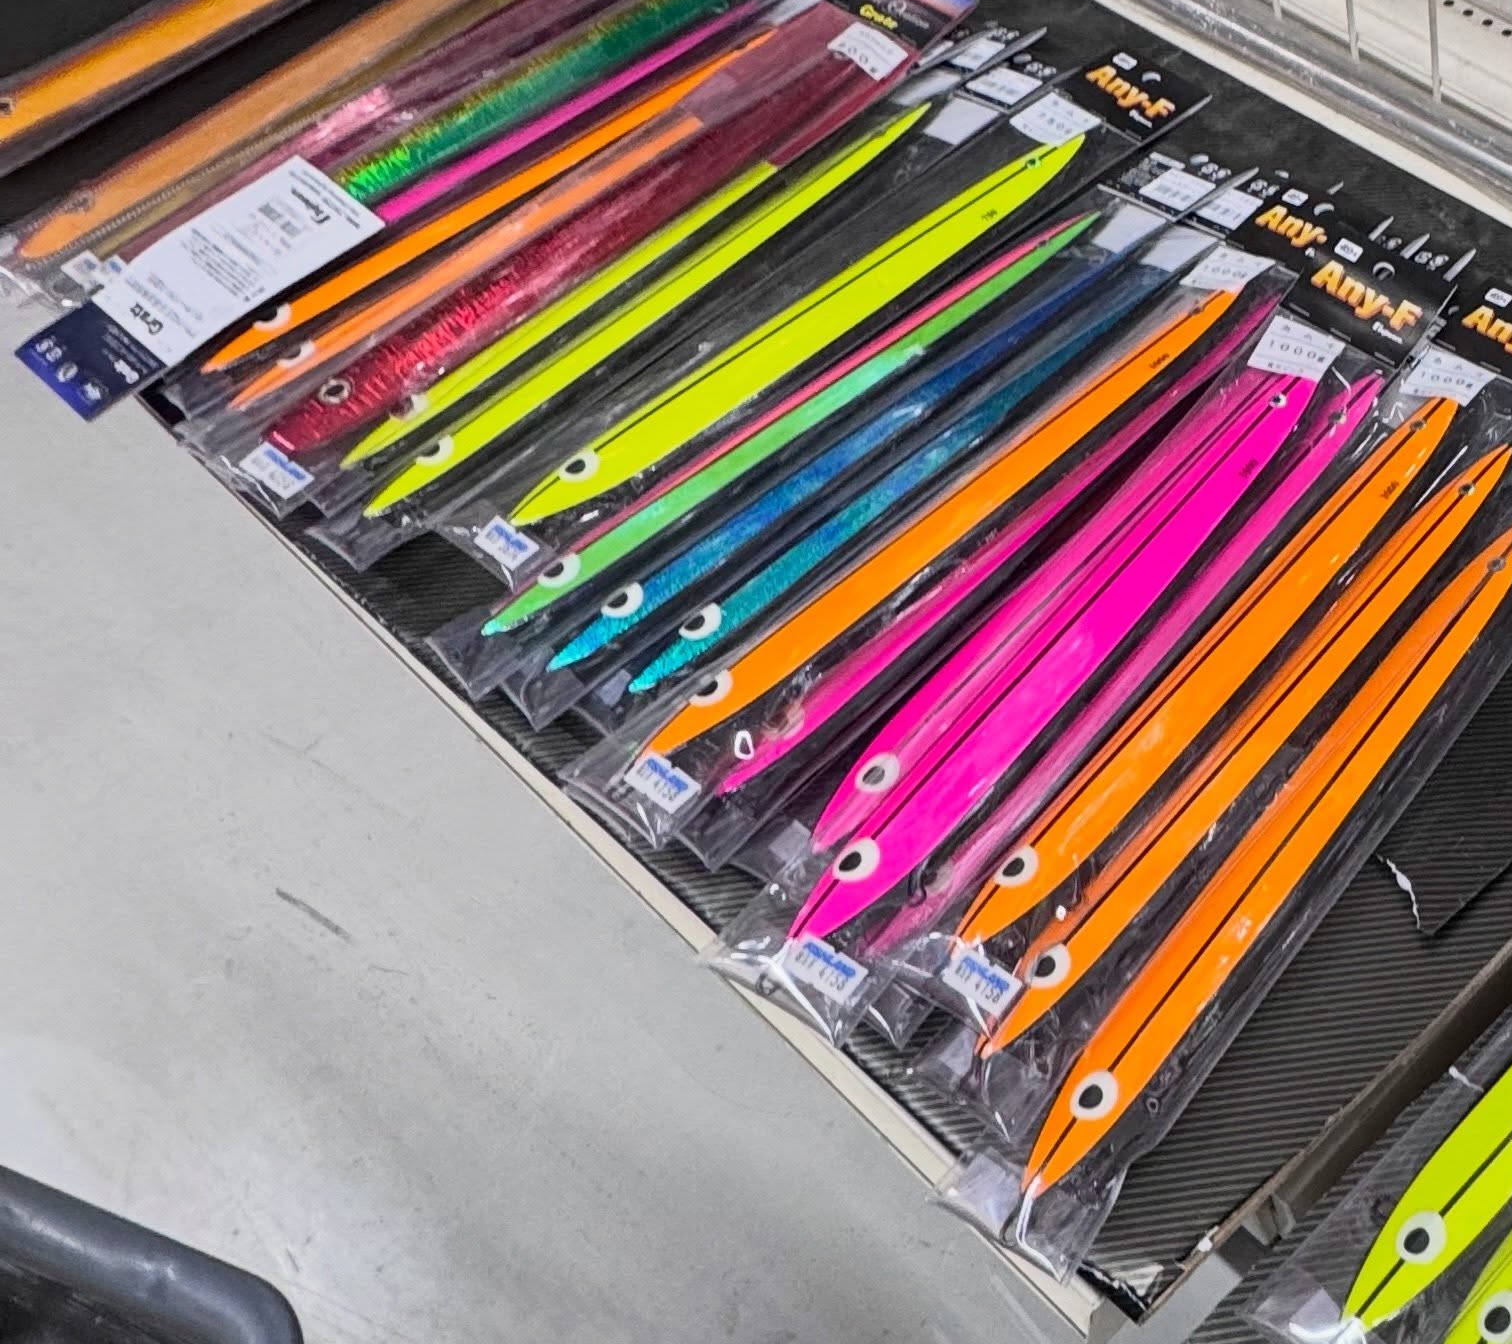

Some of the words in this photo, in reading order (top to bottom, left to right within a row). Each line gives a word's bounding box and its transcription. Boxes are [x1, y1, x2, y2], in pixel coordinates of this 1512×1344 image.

[1085, 64, 1176, 119] Any-F
[1254, 204, 1328, 248] Any-
[1310, 259, 1424, 331] Any-F
